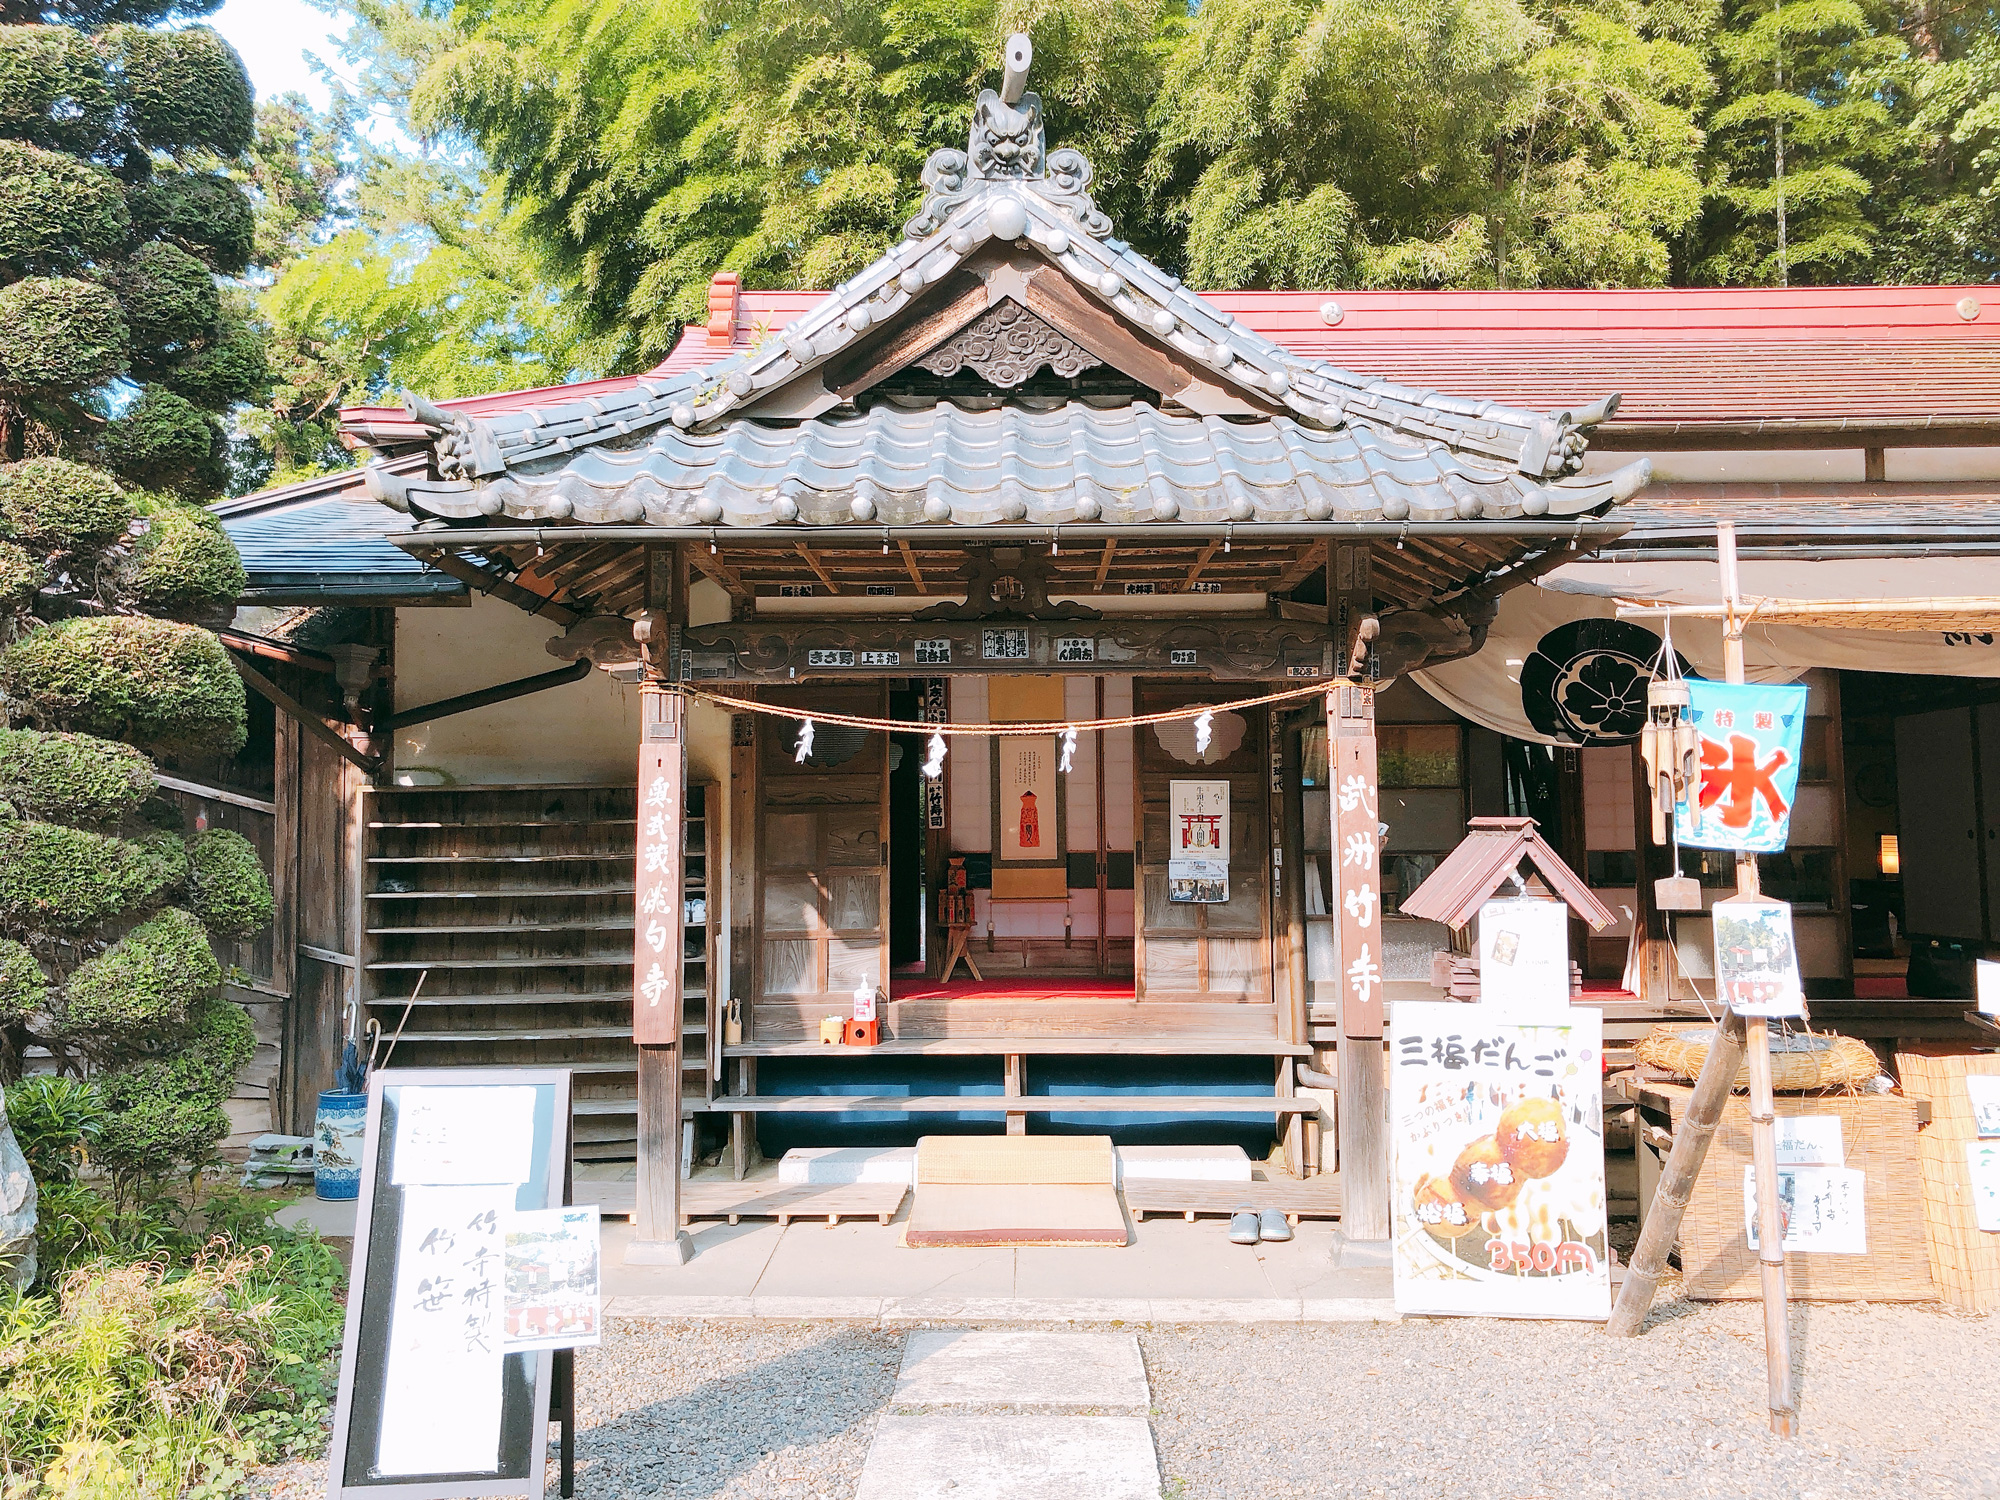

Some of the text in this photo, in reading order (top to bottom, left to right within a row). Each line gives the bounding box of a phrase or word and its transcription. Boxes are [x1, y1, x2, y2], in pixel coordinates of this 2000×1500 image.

[1699, 732, 1790, 829] 氷
[1339, 774, 1382, 1003] 武州竹寺
[1398, 1034, 1568, 1077] 三福だんご
[461, 1208, 502, 1355] 竹寺特製
[1486, 1240, 1594, 1274] 350円
